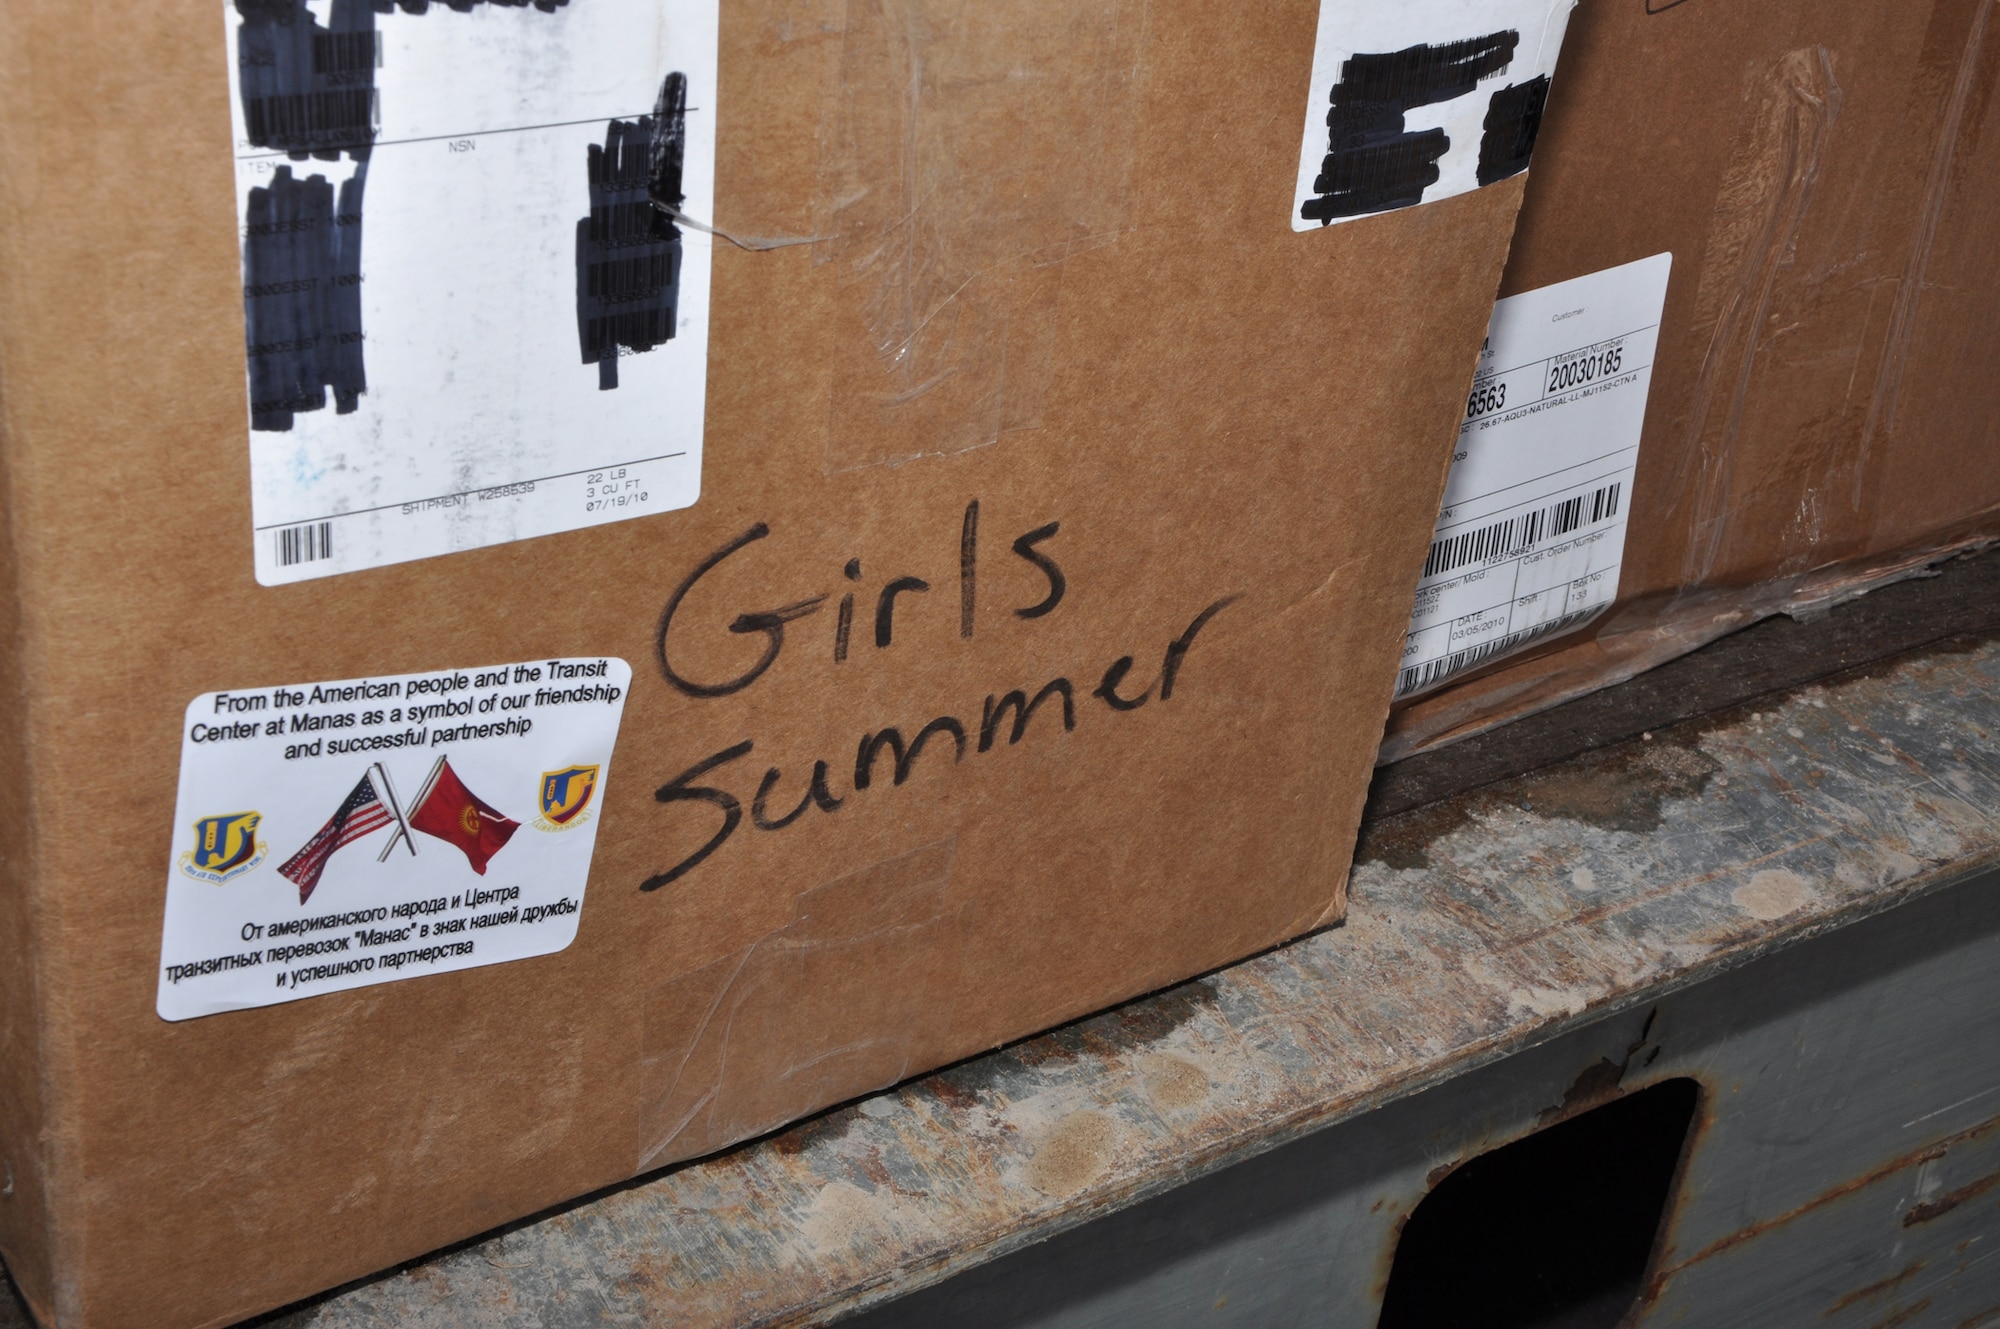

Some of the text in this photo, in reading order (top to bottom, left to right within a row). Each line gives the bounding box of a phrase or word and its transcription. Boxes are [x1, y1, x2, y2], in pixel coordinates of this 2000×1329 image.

[449, 140, 476, 153] NSN
[1548, 347, 1623, 393] 20030185
[1554, 346, 1589, 366] Material
[1467, 383, 1506, 418] 6563
[587, 469, 627, 485] 22 LB
[587, 479, 641, 498] 3 CU FT
[401, 493, 469, 515] SHIPMENT
[586, 492, 649, 512] 07/19/10
[1547, 544, 1571, 557] Order
[655, 500, 1066, 698] Girls
[1452, 616, 1505, 640] 03/05/2010
[214, 660, 608, 714] From the American people and the Transit
[191, 683, 621, 744] Center at Manas as a symbol of our friendship
[284, 716, 532, 760] and successful partnership
[640, 591, 1246, 892] Summer
[241, 885, 520, 942] От американского народа и Центра
[166, 897, 579, 984] транзитных перевозок "Манас" в знак нашей дружбы
[276, 940, 474, 989] и успешного партнерства
